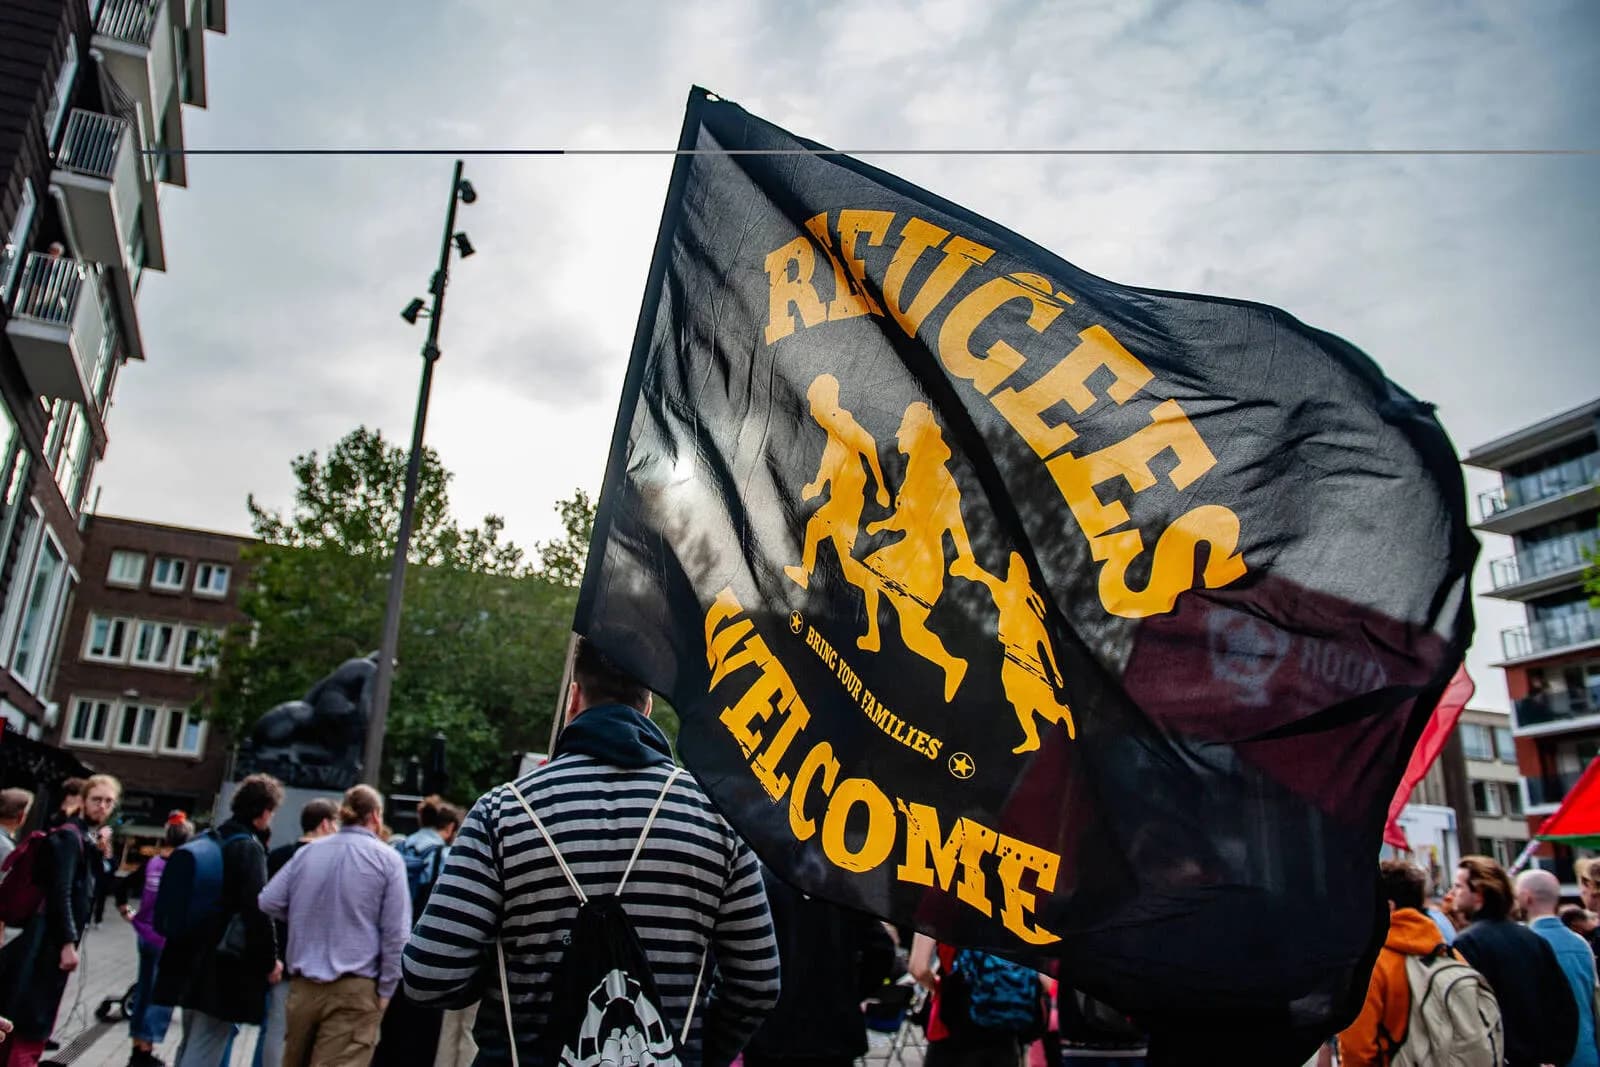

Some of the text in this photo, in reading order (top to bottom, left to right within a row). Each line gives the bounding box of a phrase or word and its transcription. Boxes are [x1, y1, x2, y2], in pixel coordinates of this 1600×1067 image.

[764, 209, 1247, 619] REFUGEES
[705, 586, 1063, 945] WELCOME
[805, 625, 943, 760] BRING YOUR FAMILIES
